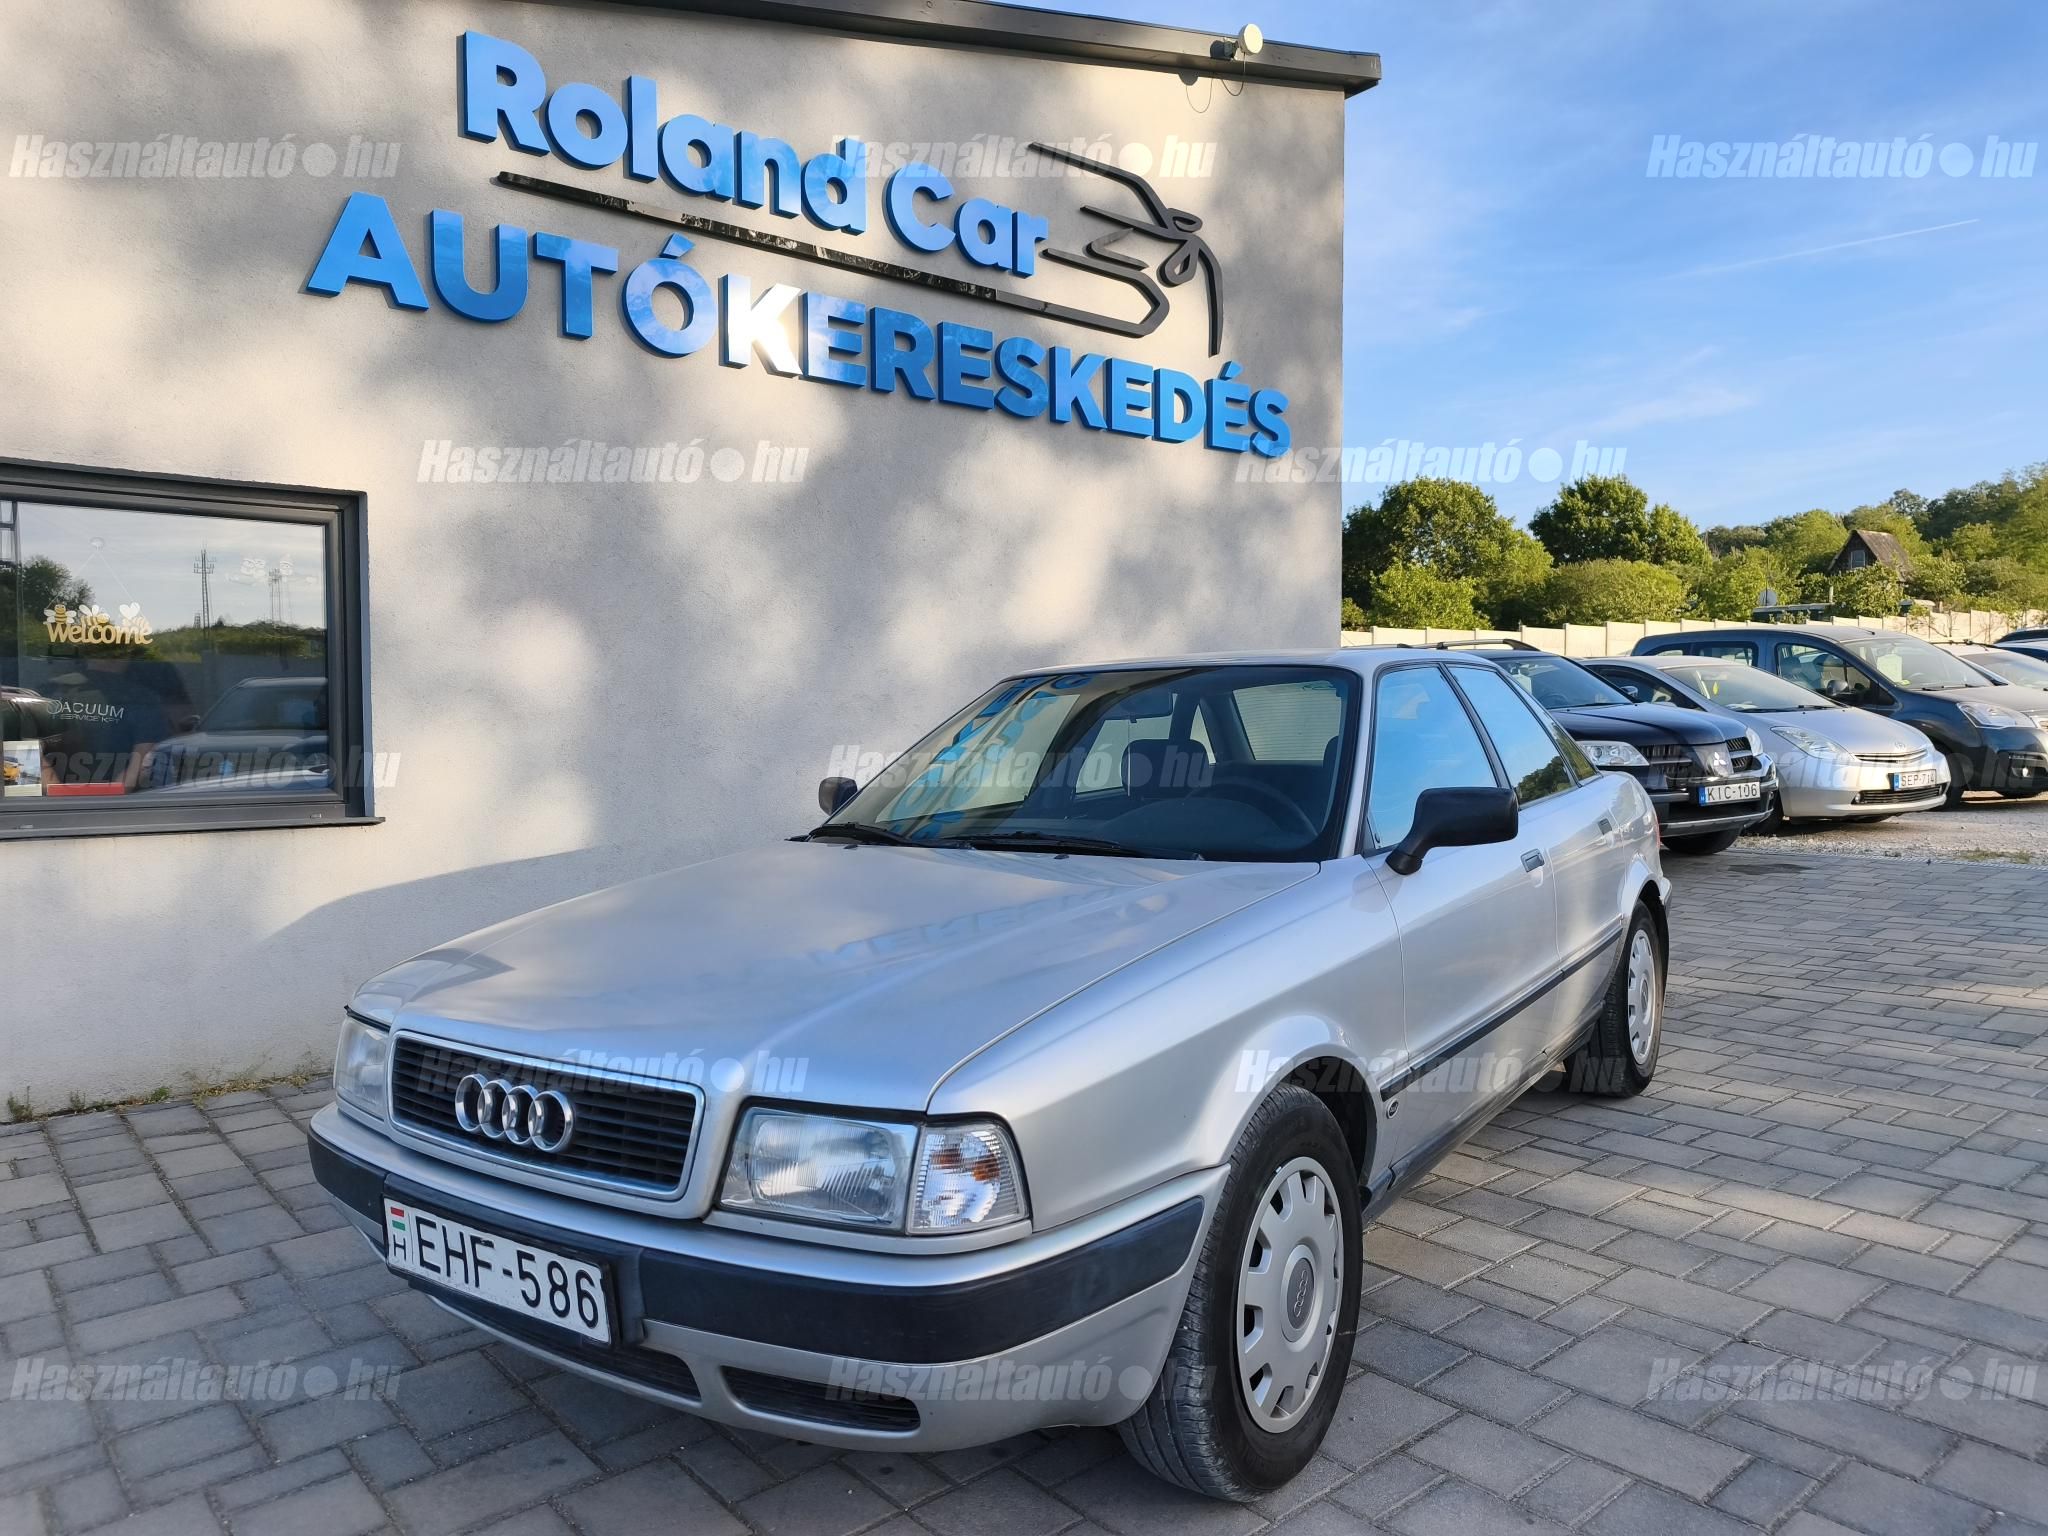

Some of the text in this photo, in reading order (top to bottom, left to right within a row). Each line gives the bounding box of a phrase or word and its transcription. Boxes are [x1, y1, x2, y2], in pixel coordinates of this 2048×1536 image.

[460, 31, 1048, 277] Roland Car
[305, 192, 1290, 458] AUTÓKERESKEDÉS
[45, 620, 153, 645] Welcome
[1707, 783, 1758, 801] KIC-106
[393, 1234, 406, 1260] H
[415, 1215, 599, 1329] EHF-586
